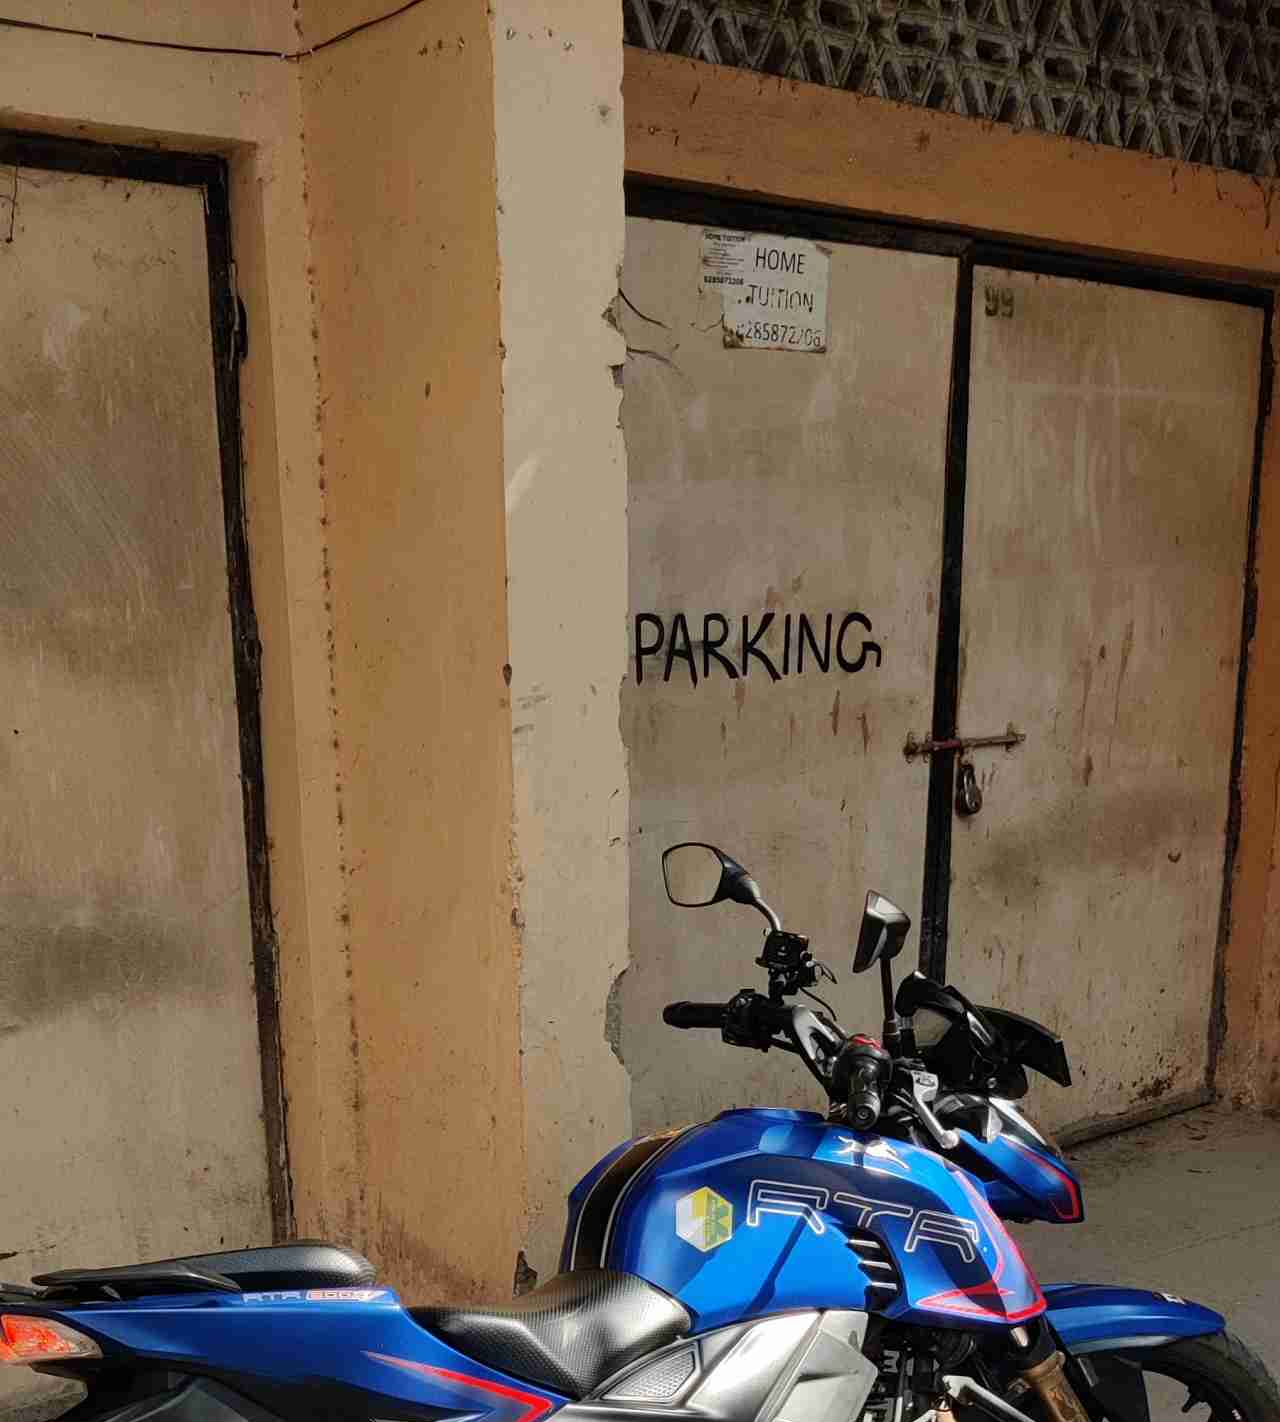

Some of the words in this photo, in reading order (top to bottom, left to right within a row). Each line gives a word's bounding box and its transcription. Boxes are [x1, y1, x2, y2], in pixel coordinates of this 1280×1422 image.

[754, 247, 807, 275] HOME
[635, 612, 882, 689] PARKING
[747, 1179, 979, 1263] RTR
[241, 1289, 302, 1304] RTR
